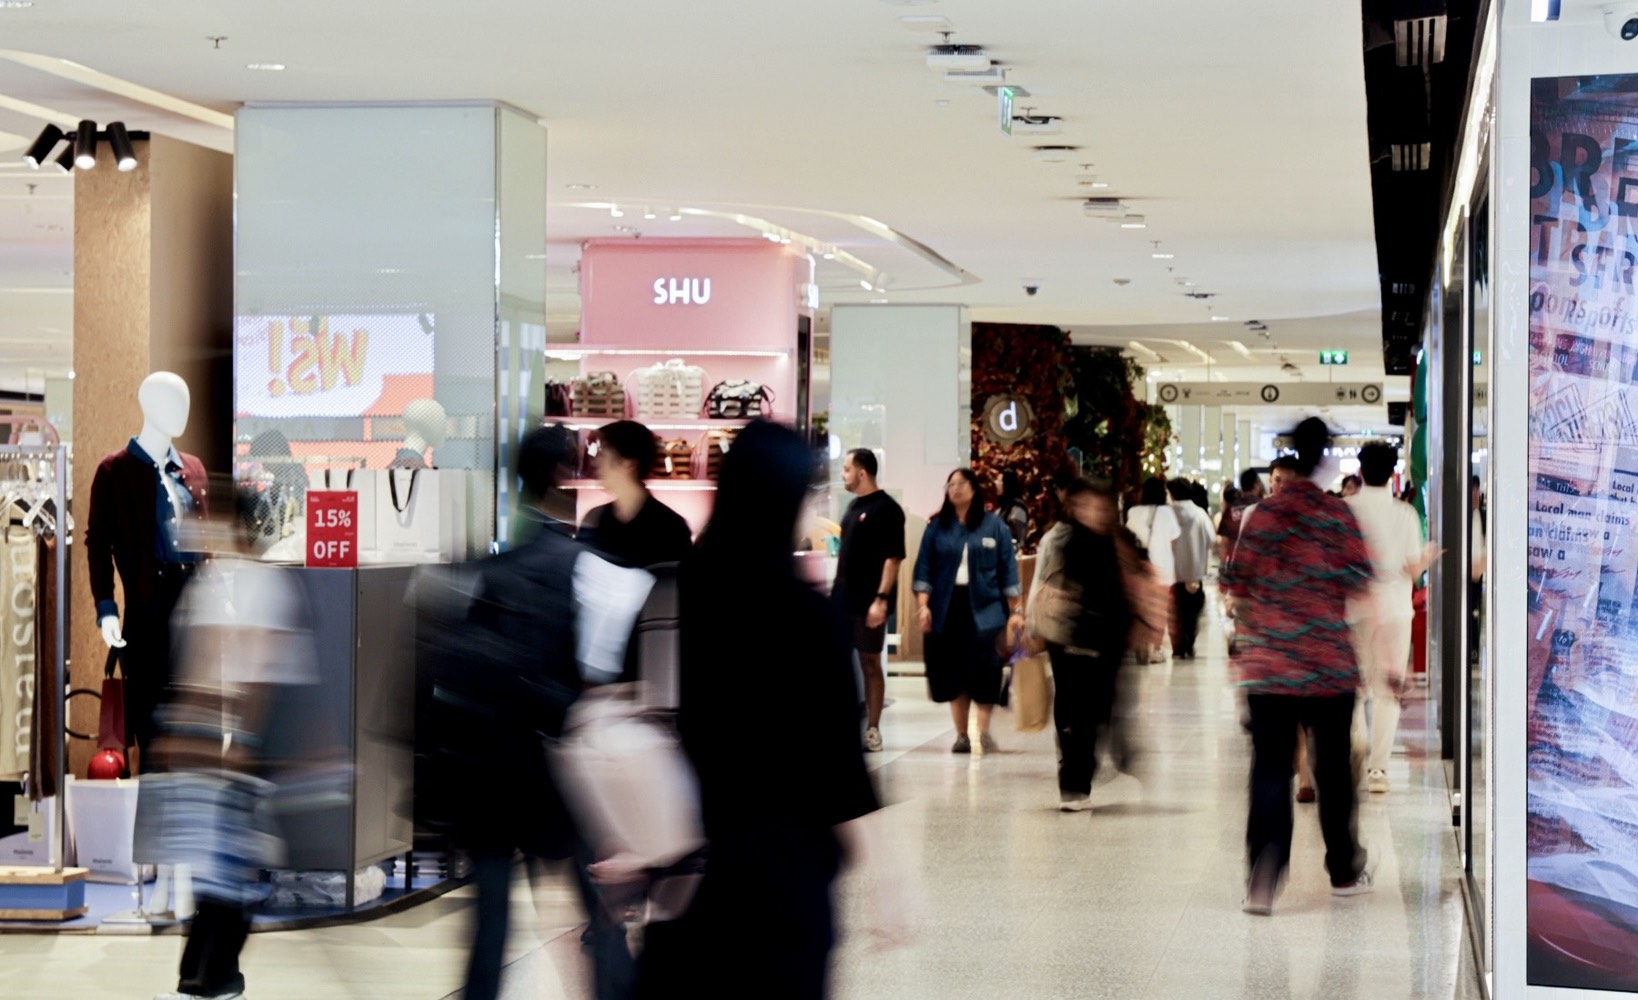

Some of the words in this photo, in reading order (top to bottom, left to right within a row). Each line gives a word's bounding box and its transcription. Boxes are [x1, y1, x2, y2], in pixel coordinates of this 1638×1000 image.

[653, 277, 711, 305] SHU
[999, 400, 1018, 432] d
[1535, 500, 1564, 515] Local
[314, 508, 352, 528] 15%
[313, 540, 350, 559] OFF
